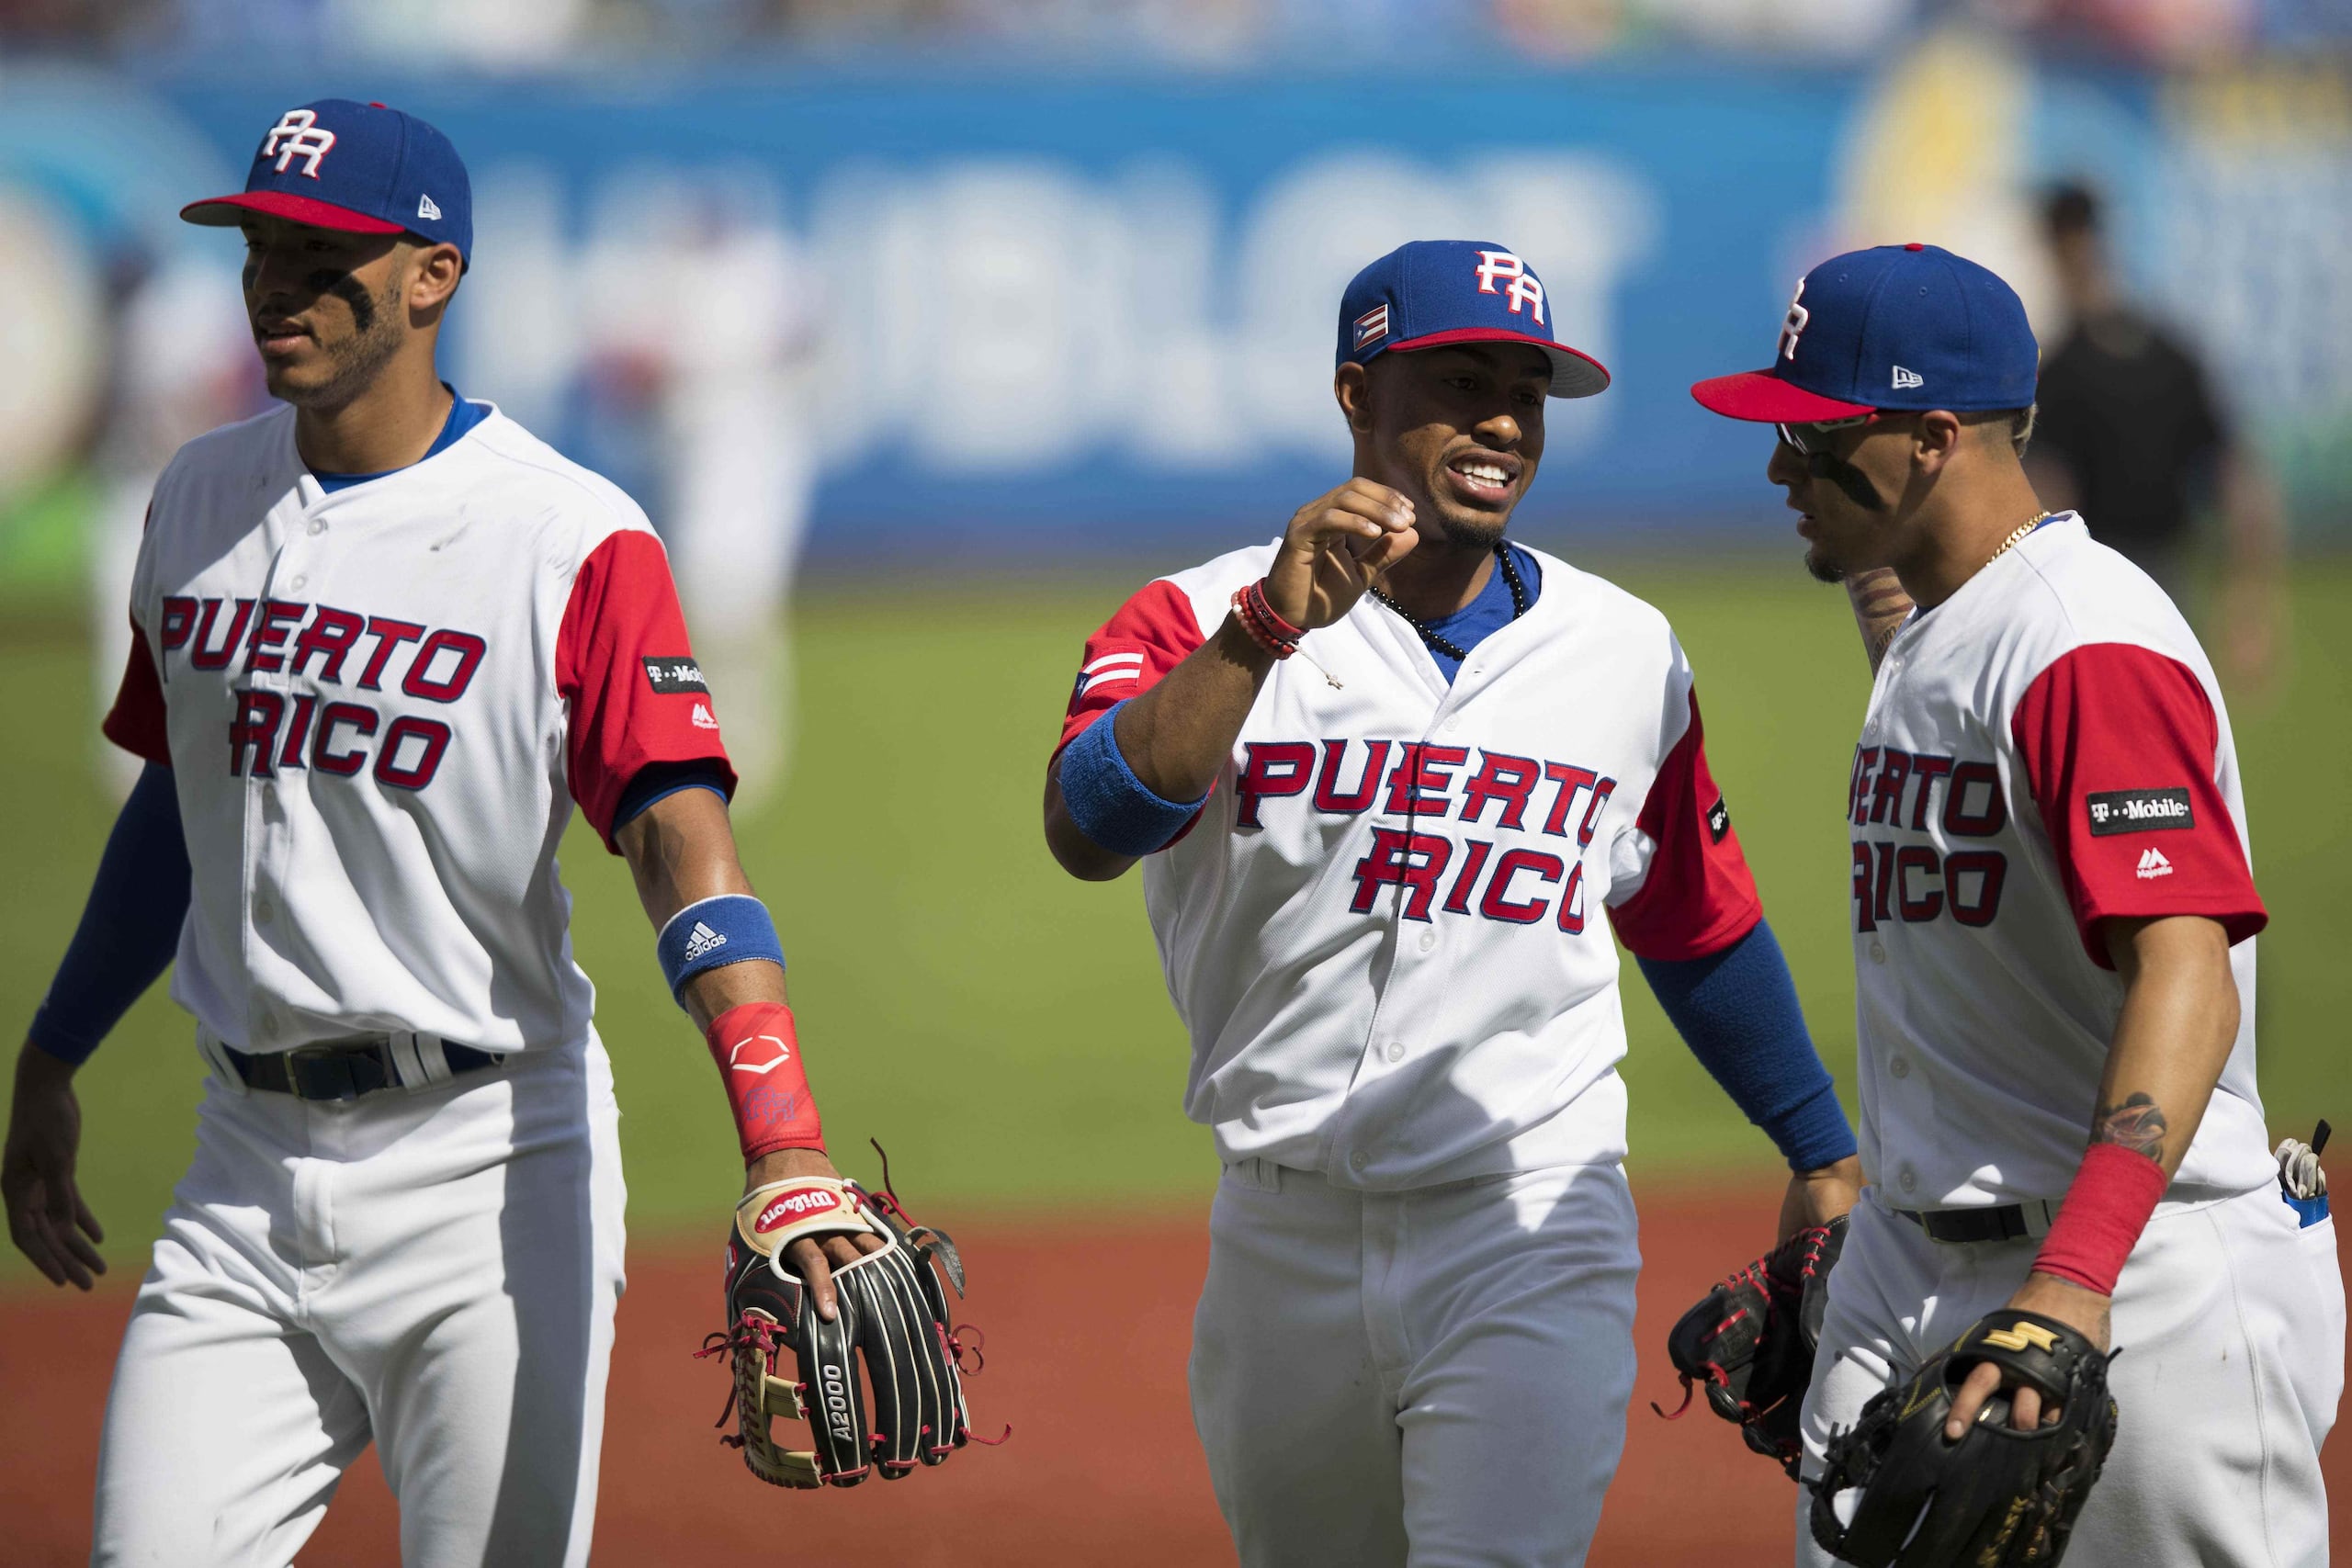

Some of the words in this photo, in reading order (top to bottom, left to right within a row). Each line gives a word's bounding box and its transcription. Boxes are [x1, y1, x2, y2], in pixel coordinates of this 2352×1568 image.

[161, 595, 487, 704] PUERTO
[229, 689, 451, 792] RICO
[1236, 739, 1617, 848] PUERTO
[1349, 826, 1584, 935] RICO
[685, 934, 727, 961] adidas
[761, 1190, 836, 1224] Wilson
[823, 1364, 854, 1442] A2000
